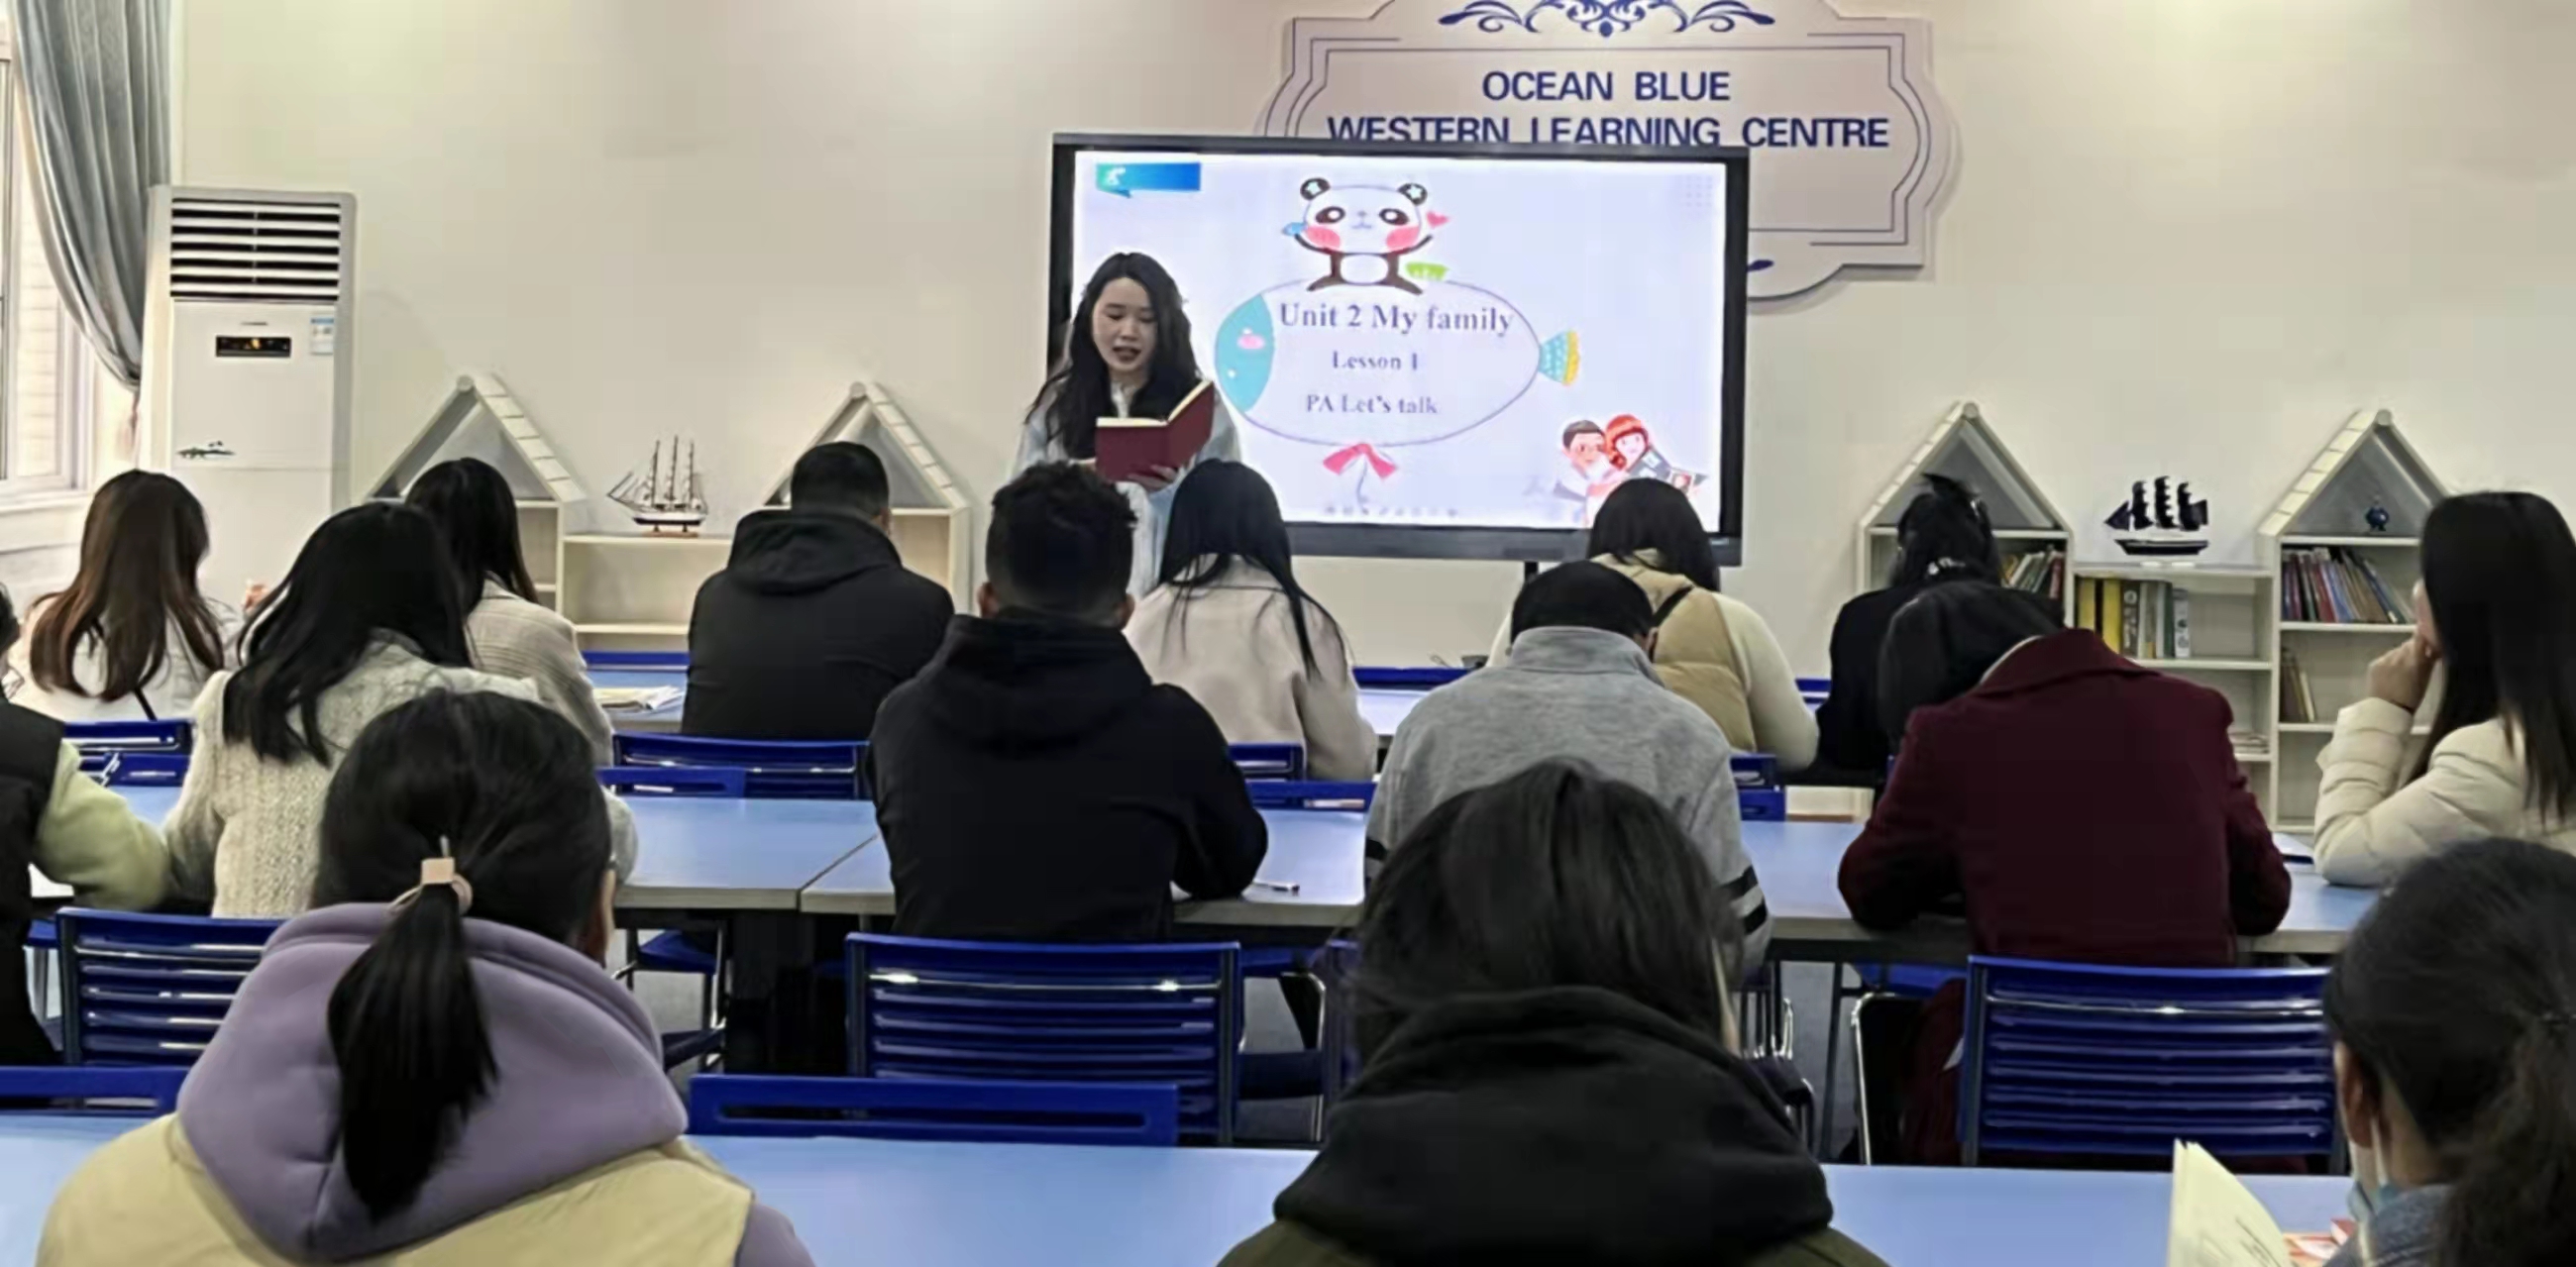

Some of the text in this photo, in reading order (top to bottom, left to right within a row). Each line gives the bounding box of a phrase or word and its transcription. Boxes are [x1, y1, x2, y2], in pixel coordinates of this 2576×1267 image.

[1482, 70, 1731, 101] OCEAN BLUE
[1327, 116, 1889, 148] WESTERN LEARNING CENTRE
[1280, 302, 1512, 338] Unit 2 My family
[1333, 350, 1402, 370] Lesson
[1306, 393, 1335, 413] PA
[1398, 395, 1439, 414] talk
